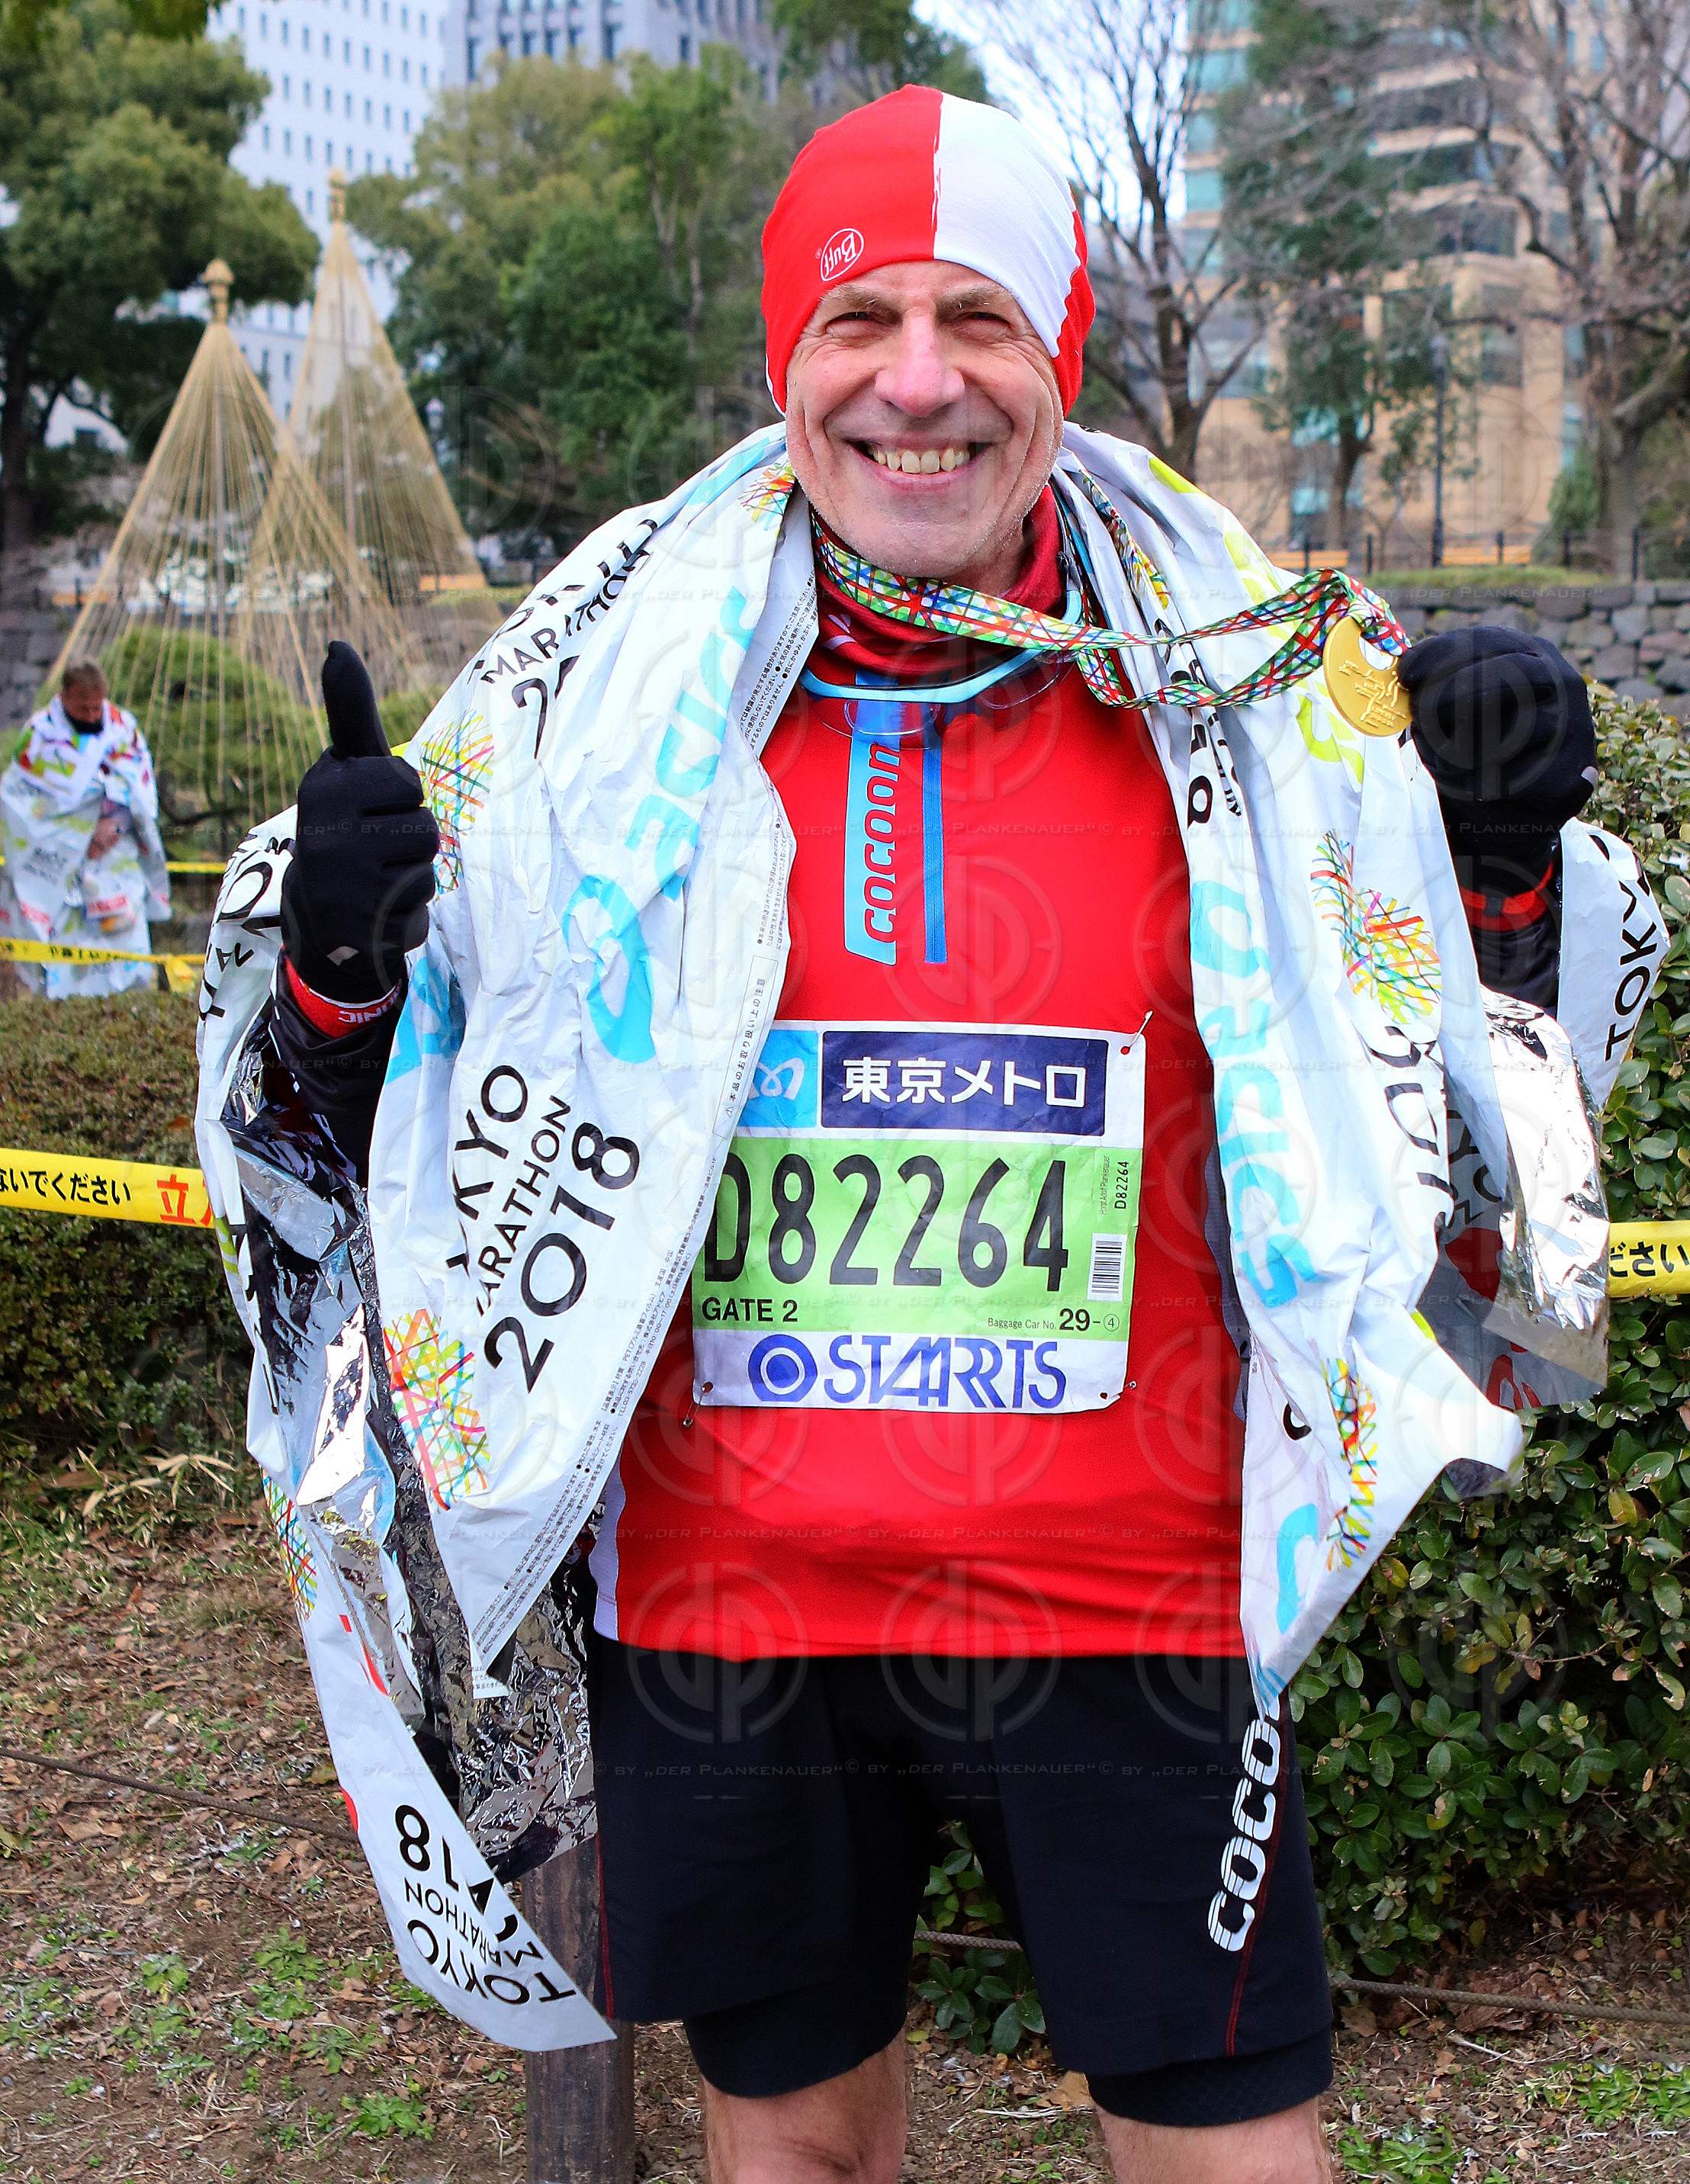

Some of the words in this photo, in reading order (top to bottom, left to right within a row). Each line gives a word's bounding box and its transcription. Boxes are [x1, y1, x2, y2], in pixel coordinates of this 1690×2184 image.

[842, 1056, 1088, 1108] 東京メトロ
[1113, 1161, 1129, 1209] D82264
[704, 1152, 1069, 1293] D82264
[484, 1122, 641, 1395] 2018
[702, 1297, 774, 1324] GATE
[782, 1299, 798, 1324] 2
[988, 1318, 1023, 1329] Baggage
[1025, 1319, 1040, 1329] Car
[404, 1877, 544, 1968] MARATHON
[406, 1919, 577, 2005] TOKYO
